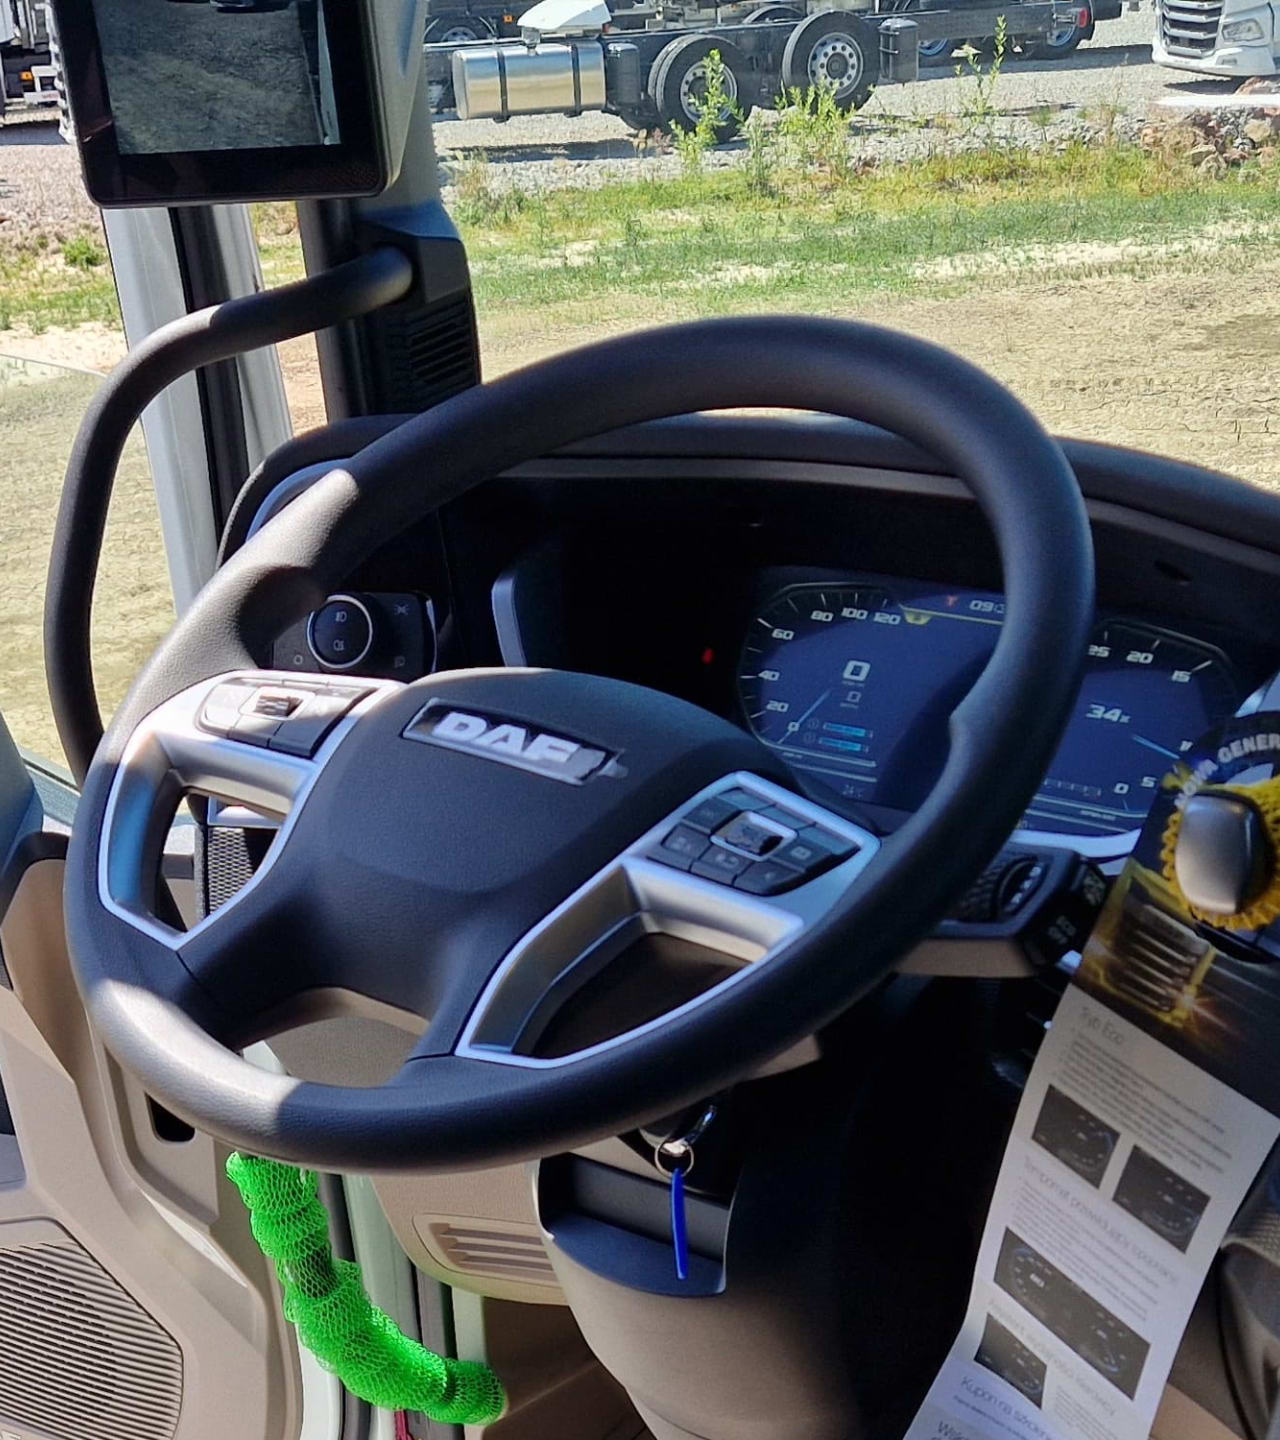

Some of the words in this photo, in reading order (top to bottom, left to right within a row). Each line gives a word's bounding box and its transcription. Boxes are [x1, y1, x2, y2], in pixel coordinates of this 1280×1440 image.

[810, 610, 834, 622] 80
[841, 606, 869, 620] 100
[872, 611, 902, 625] 120
[771, 627, 795, 641] 60
[1125, 650, 1154, 664] 20
[760, 669, 781, 681] 40
[1169, 669, 1192, 683] 15
[765, 699, 789, 712] 20
[431, 711, 581, 763] DAF
[1114, 782, 1130, 795] 0
[1140, 776, 1158, 788] 5
[960, 1376, 1000, 1411] Kupon
